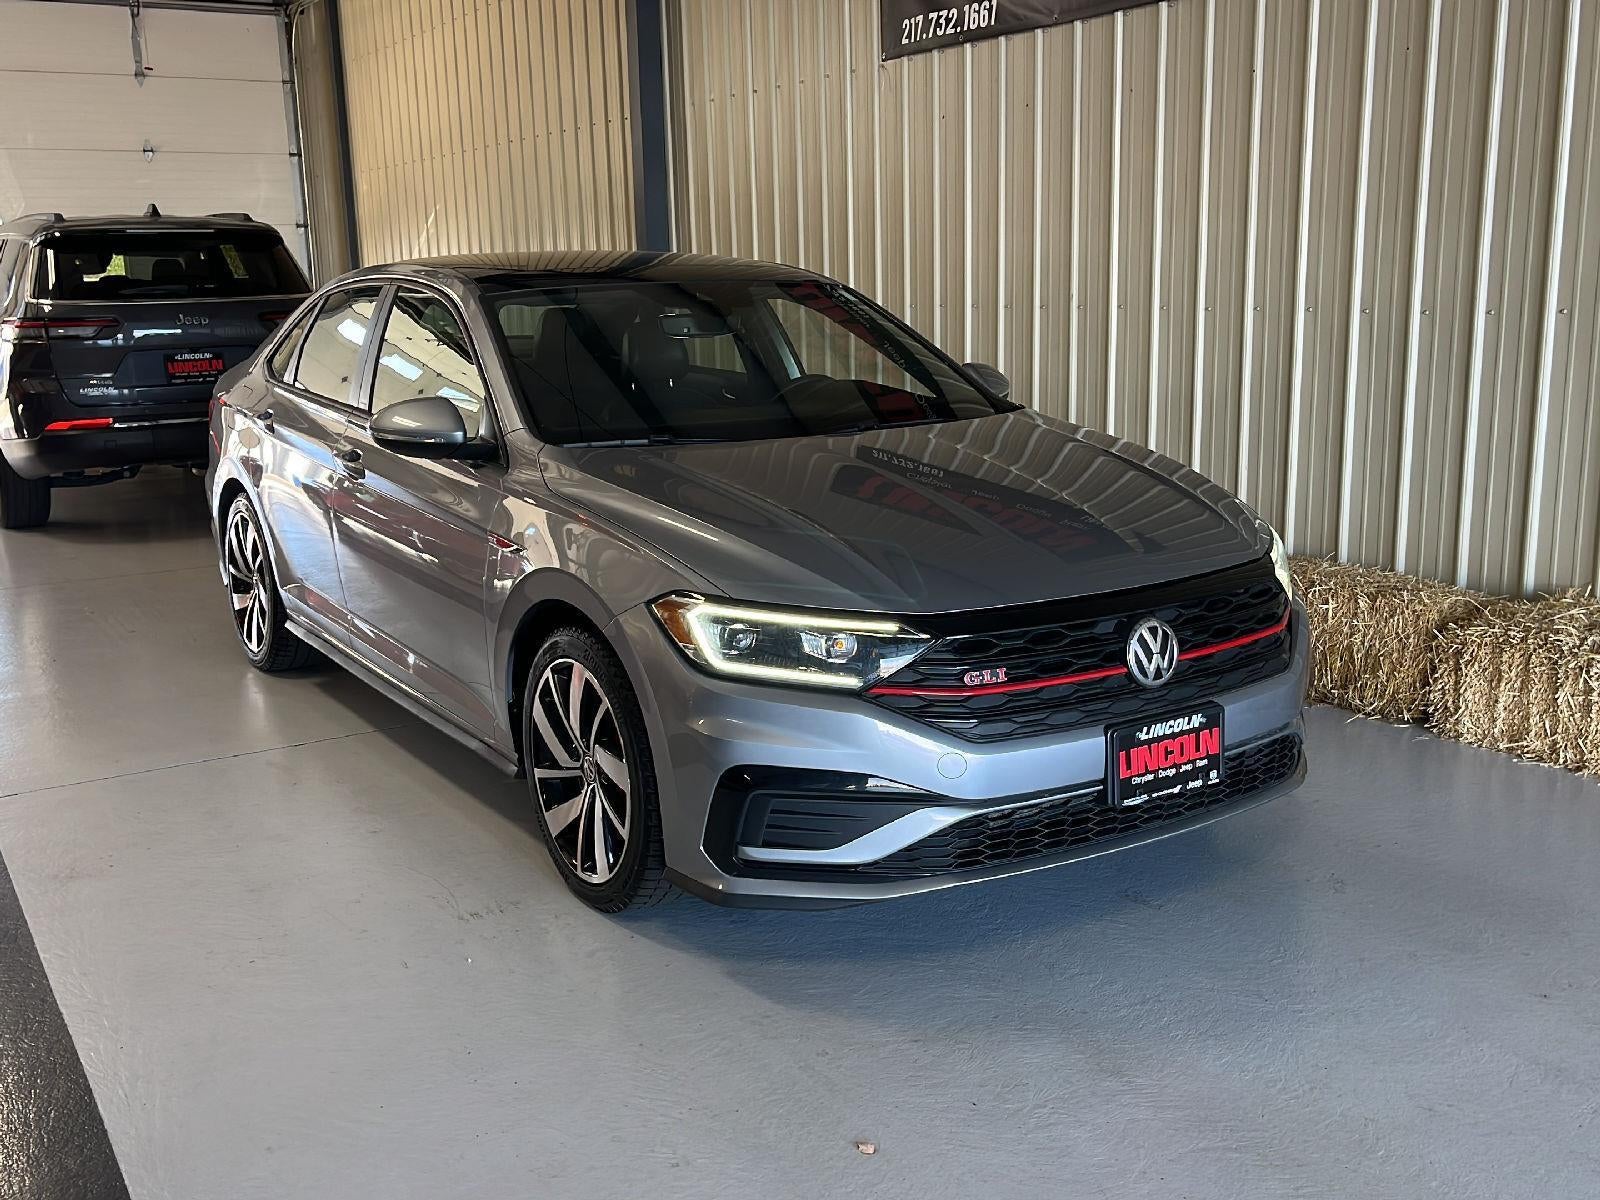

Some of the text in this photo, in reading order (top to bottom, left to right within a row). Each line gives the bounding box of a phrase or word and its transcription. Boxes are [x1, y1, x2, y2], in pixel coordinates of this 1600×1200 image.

[902, 0, 997, 44] 217.732.1661
[176, 313, 209, 326] Jeep
[177, 352, 210, 360] LINCOLN
[168, 359, 223, 373] LINCOLN
[964, 667, 1008, 686] GLI
[1139, 713, 1203, 740] LINCOLN
[1120, 727, 1220, 779] LINCOLN
[1132, 772, 1155, 784] Chrysler
[1158, 767, 1177, 778] Dodge
[1179, 762, 1193, 773] Jeep
[1186, 779, 1203, 789] Jeep
